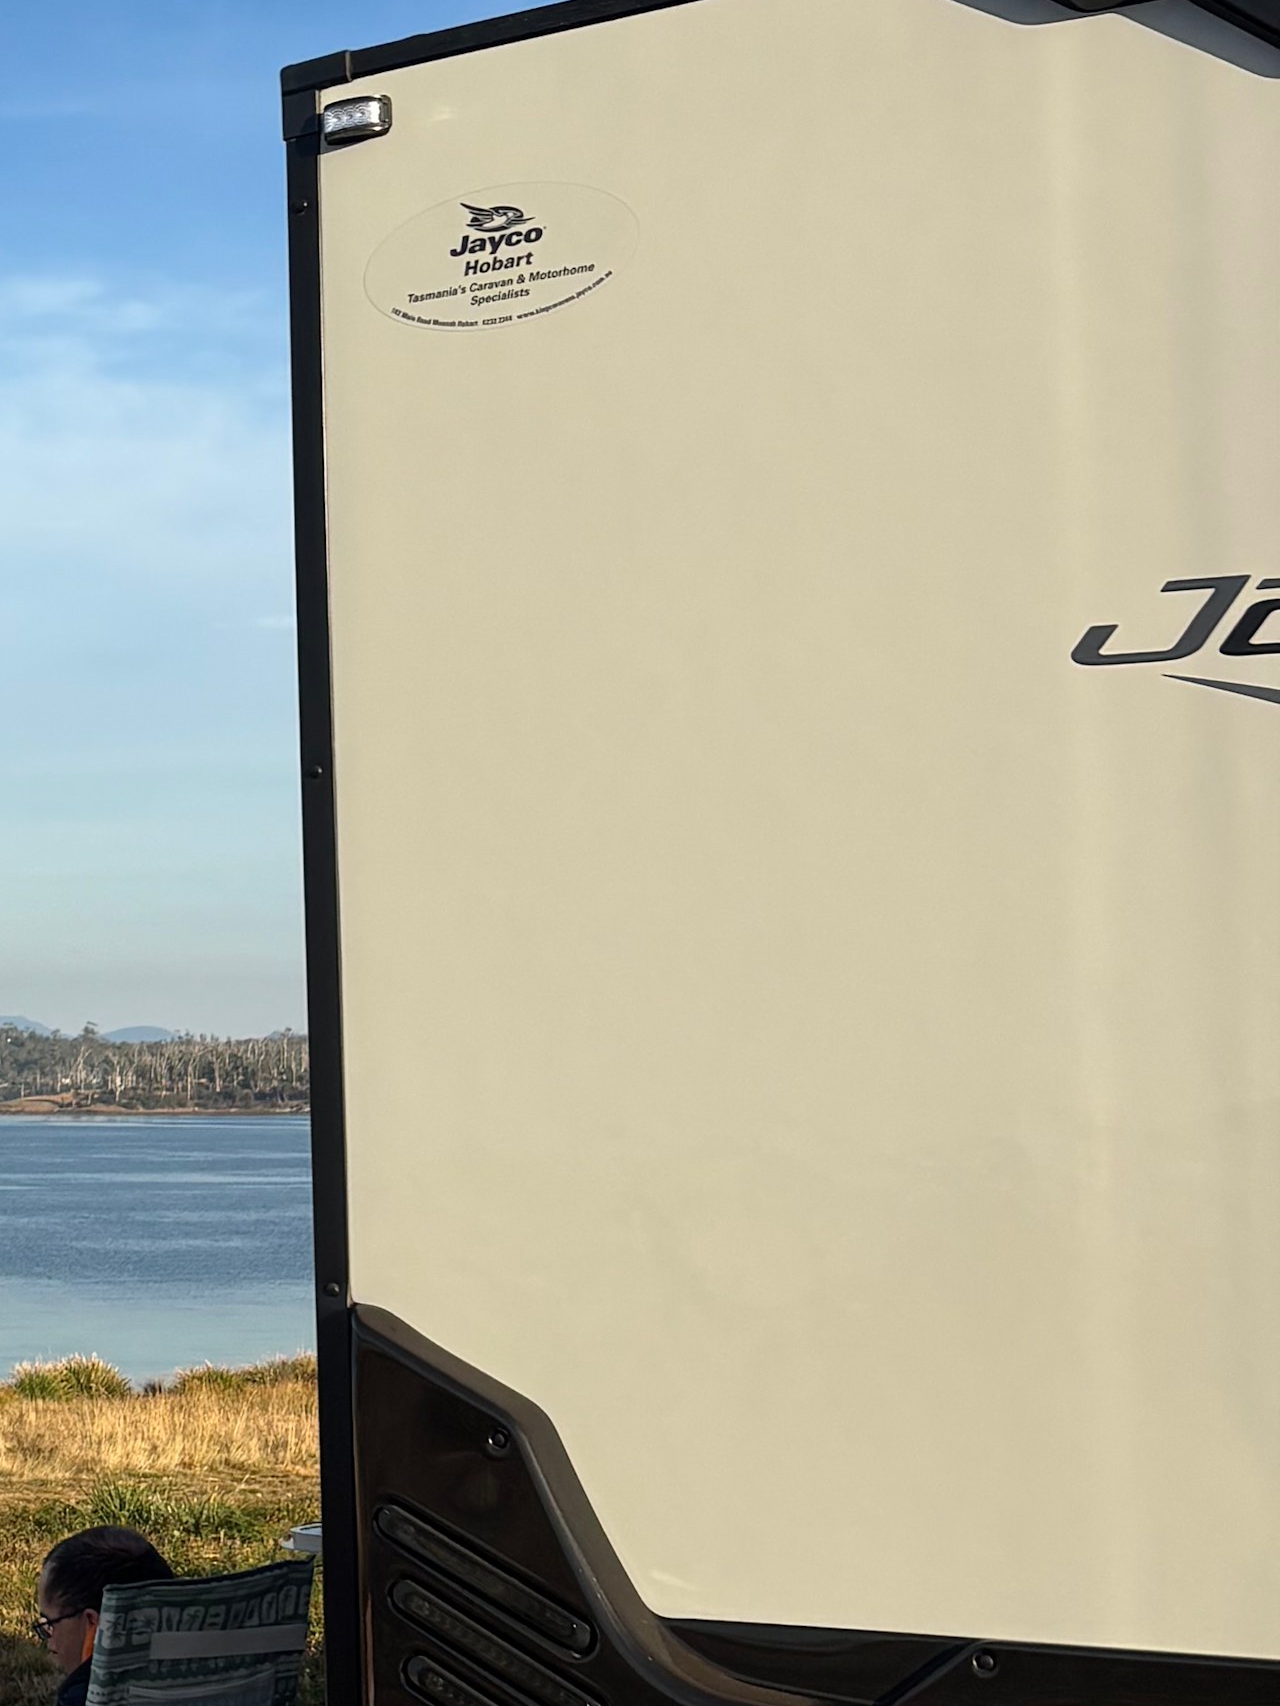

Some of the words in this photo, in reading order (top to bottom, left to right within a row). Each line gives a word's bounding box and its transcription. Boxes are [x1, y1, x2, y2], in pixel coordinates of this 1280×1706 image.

[450, 226, 544, 257] Jayco
[463, 252, 534, 276] Hobart
[408, 284, 467, 304] Tasmania's
[469, 277, 513, 293] Caravan
[516, 274, 526, 284] &
[528, 262, 595, 283] Motorhome
[470, 287, 530, 306] Specialists
